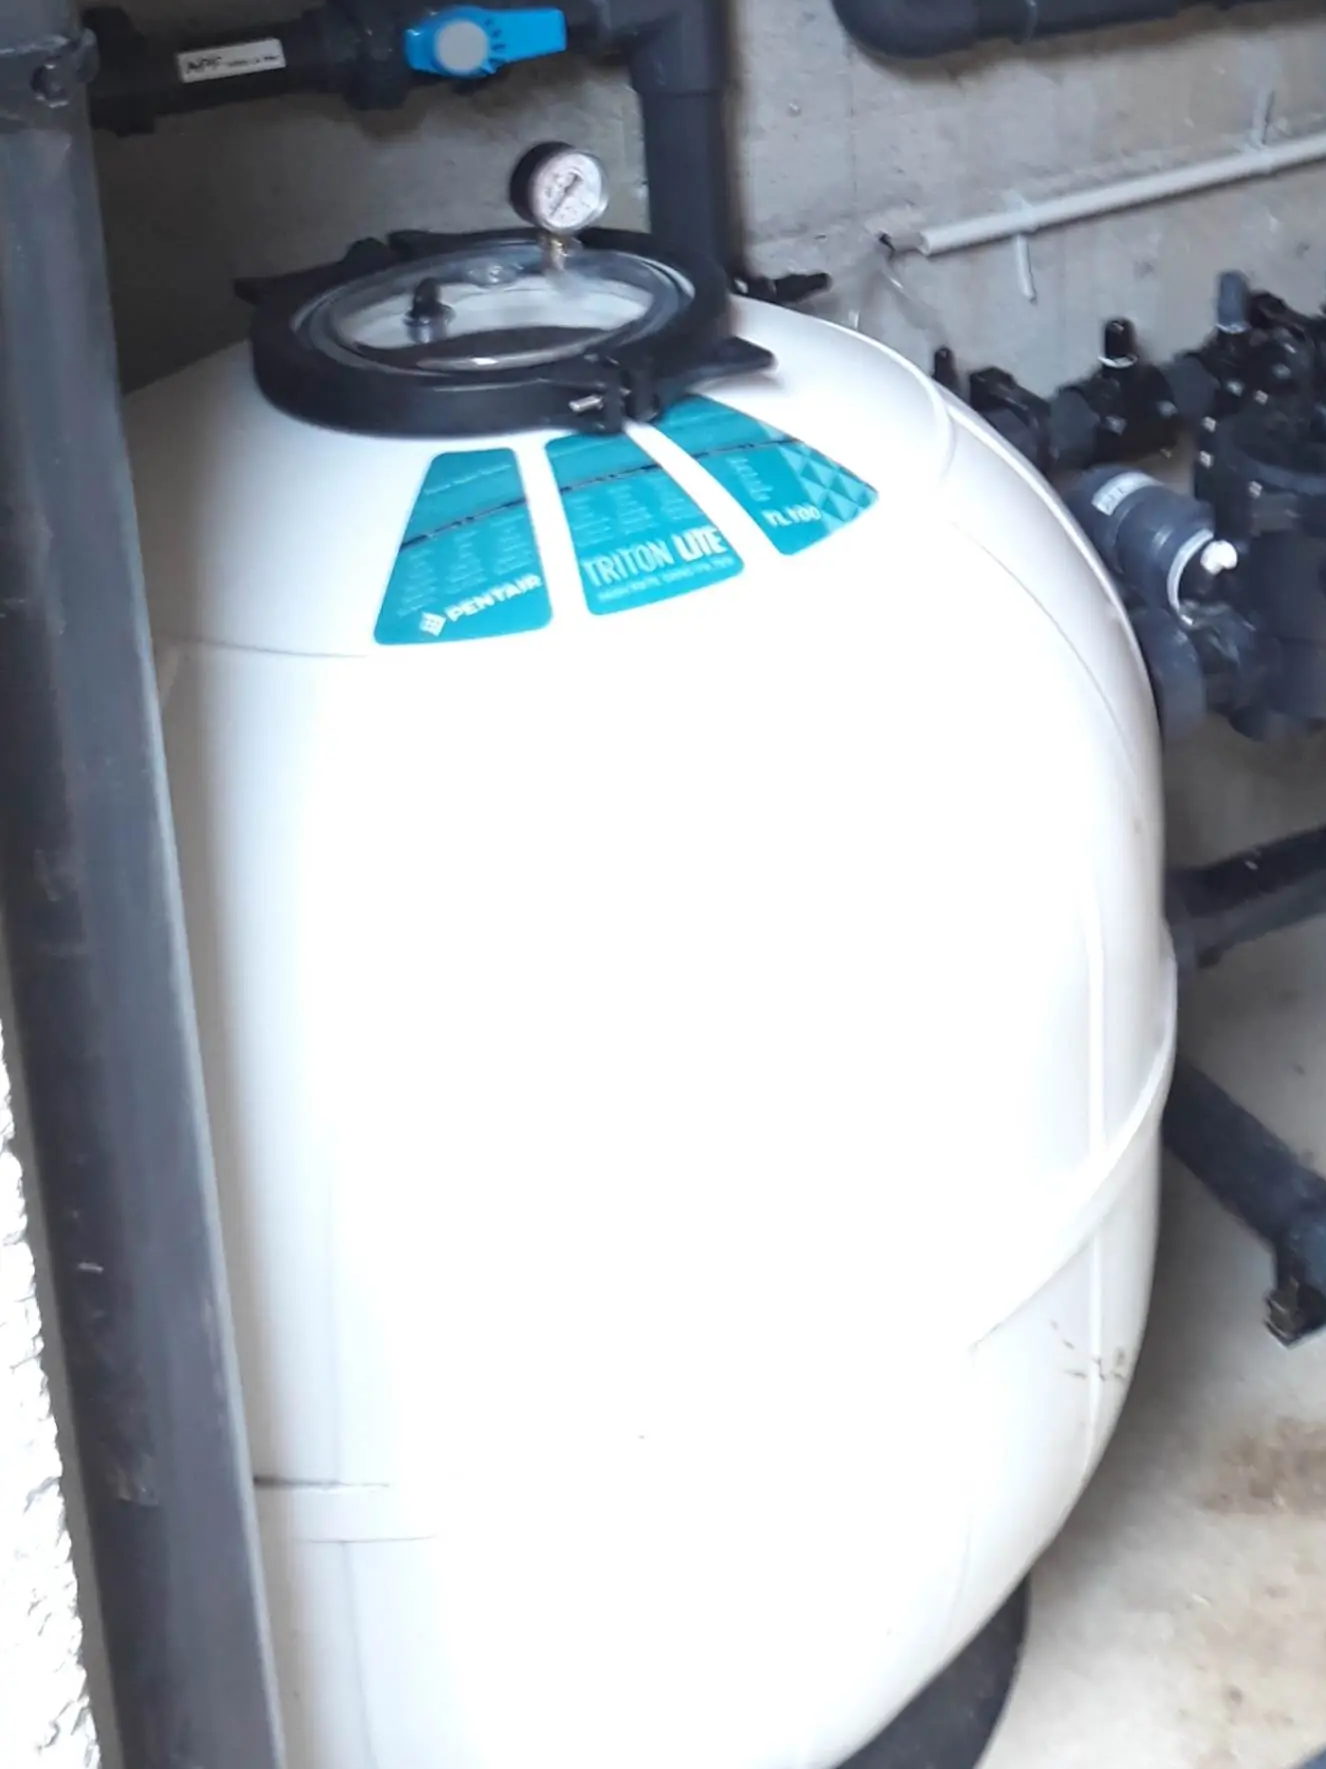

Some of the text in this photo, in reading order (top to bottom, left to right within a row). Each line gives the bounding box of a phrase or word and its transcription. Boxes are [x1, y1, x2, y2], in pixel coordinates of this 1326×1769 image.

[581, 537, 675, 588] TRITON
[670, 524, 729, 563] LITE
[443, 572, 544, 623] PENTAIR
